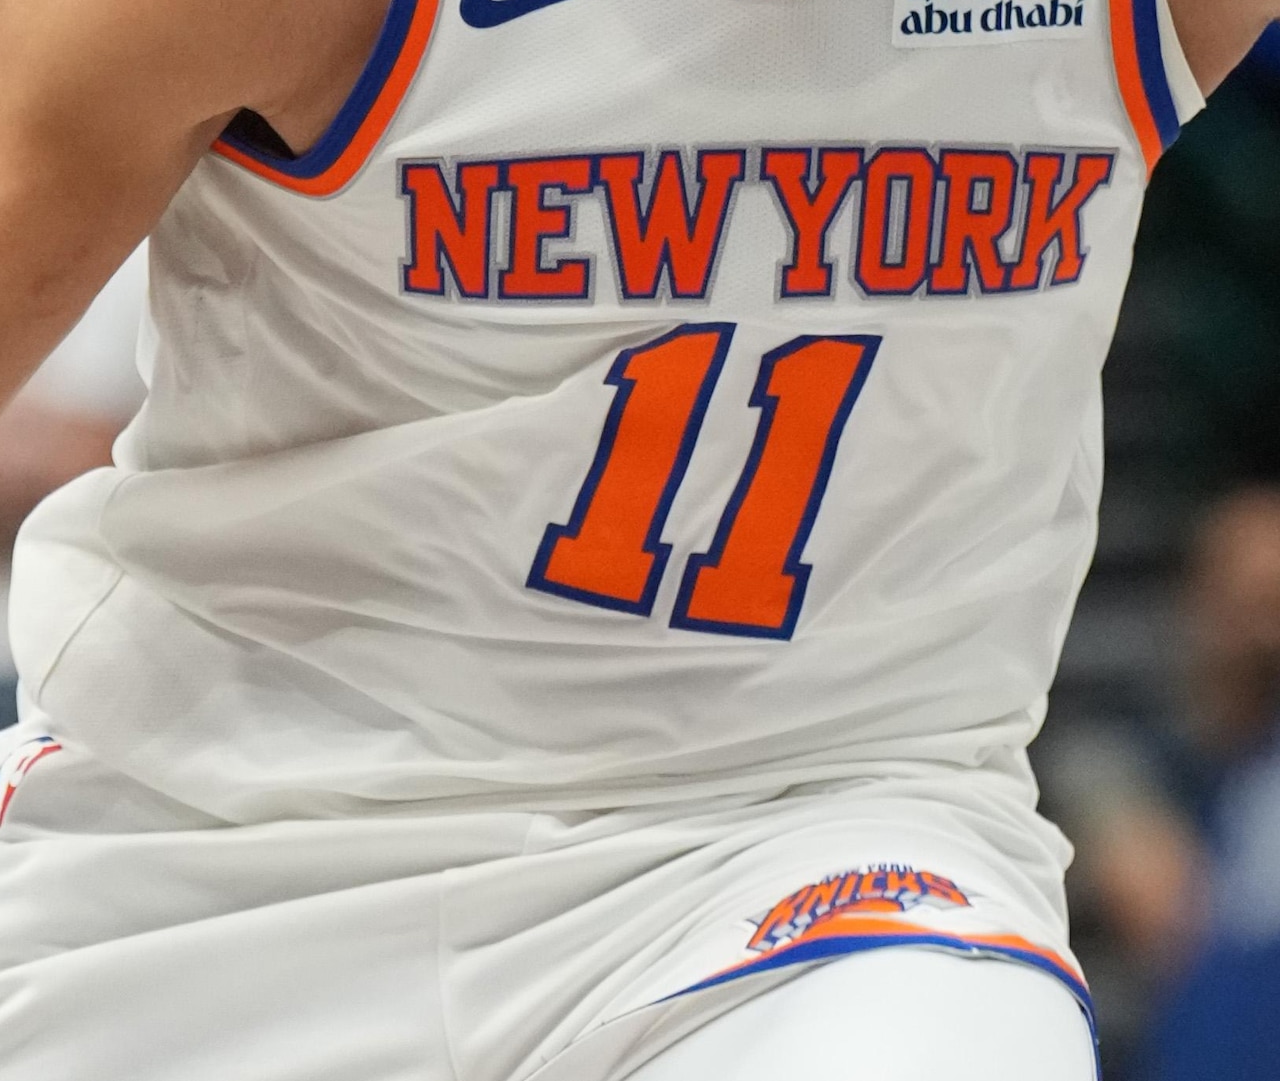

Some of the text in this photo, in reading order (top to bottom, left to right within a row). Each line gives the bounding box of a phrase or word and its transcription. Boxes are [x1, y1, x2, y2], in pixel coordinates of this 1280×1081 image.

[900, 2, 973, 35] abu
[396, 140, 1120, 306] NEW YORK
[525, 321, 883, 640] 11
[745, 870, 973, 951] KNICKS
